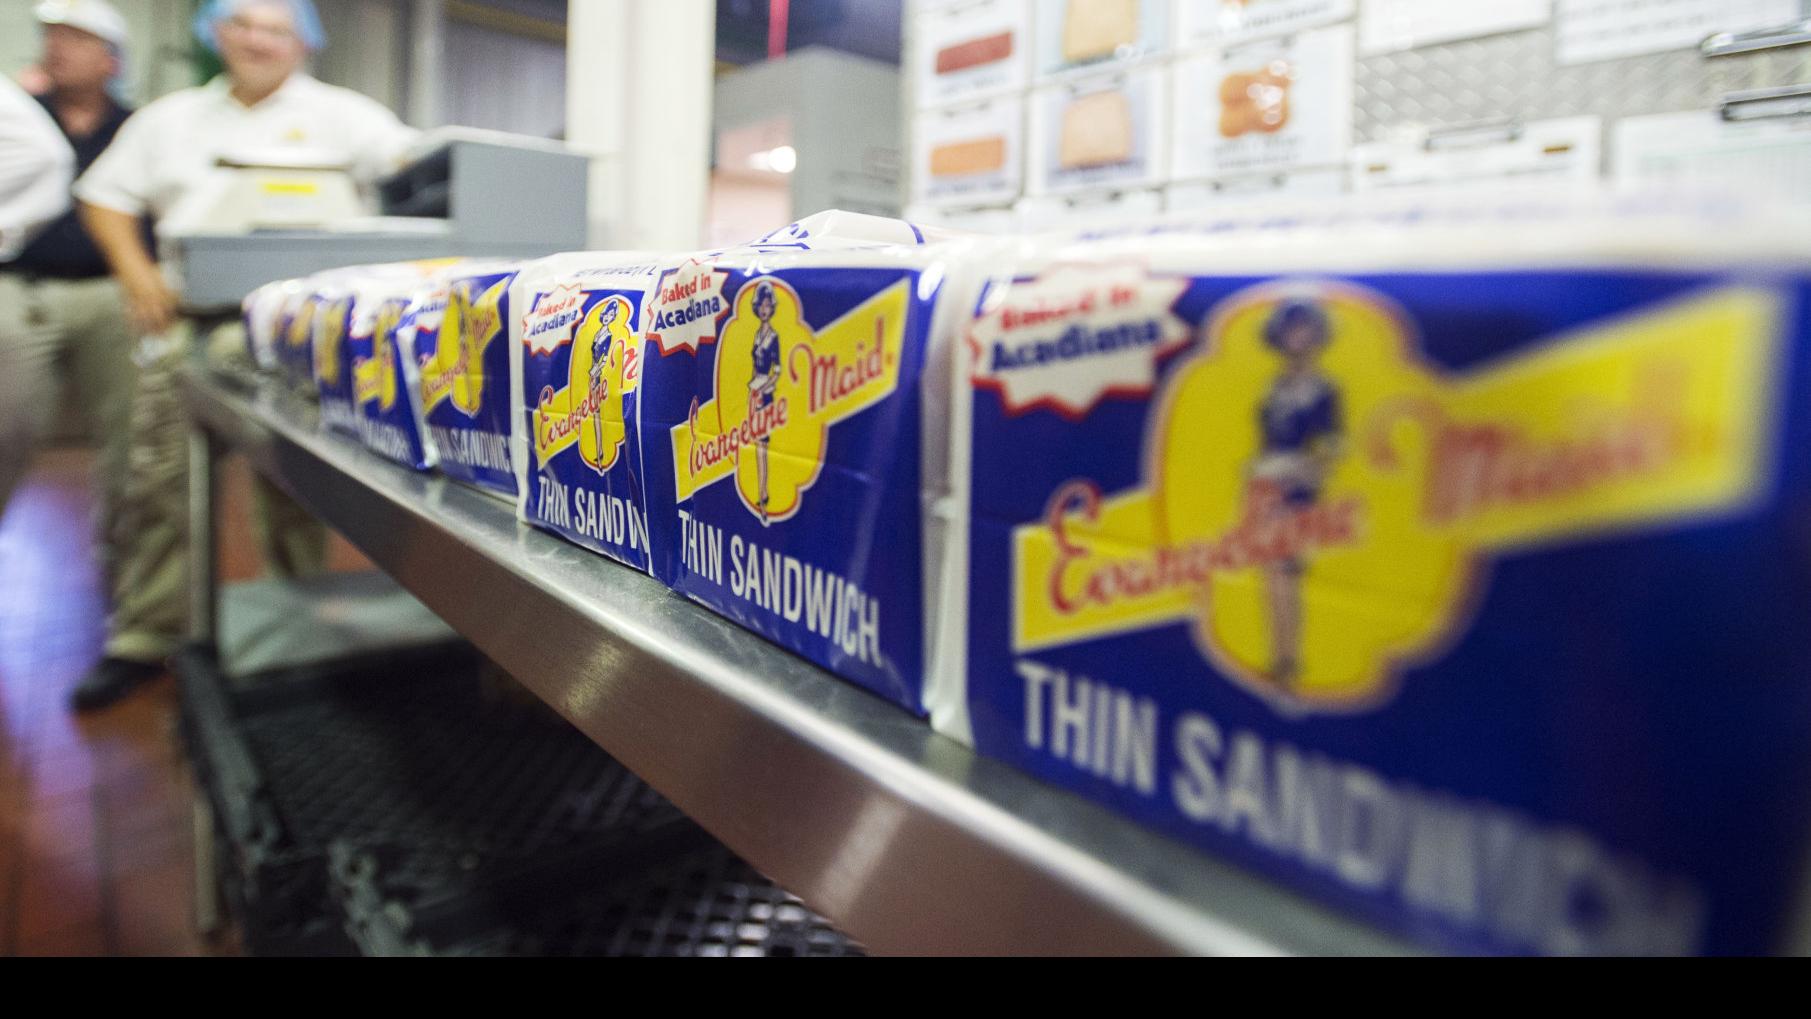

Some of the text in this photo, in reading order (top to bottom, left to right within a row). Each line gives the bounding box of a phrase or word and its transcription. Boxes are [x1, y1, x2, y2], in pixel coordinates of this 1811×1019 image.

[653, 295, 721, 332] Acadiana
[661, 272, 712, 305] Baked in
[530, 309, 579, 336] Acadiana
[990, 319, 1163, 373] Acadiana
[538, 379, 608, 450] Evangeline
[689, 394, 787, 480] Evangeline
[449, 428, 513, 473] SANDWIC
[537, 476, 650, 553] THIN SANDW
[677, 509, 883, 669] THIN SANDWICH
[1014, 658, 1158, 797] THIN
